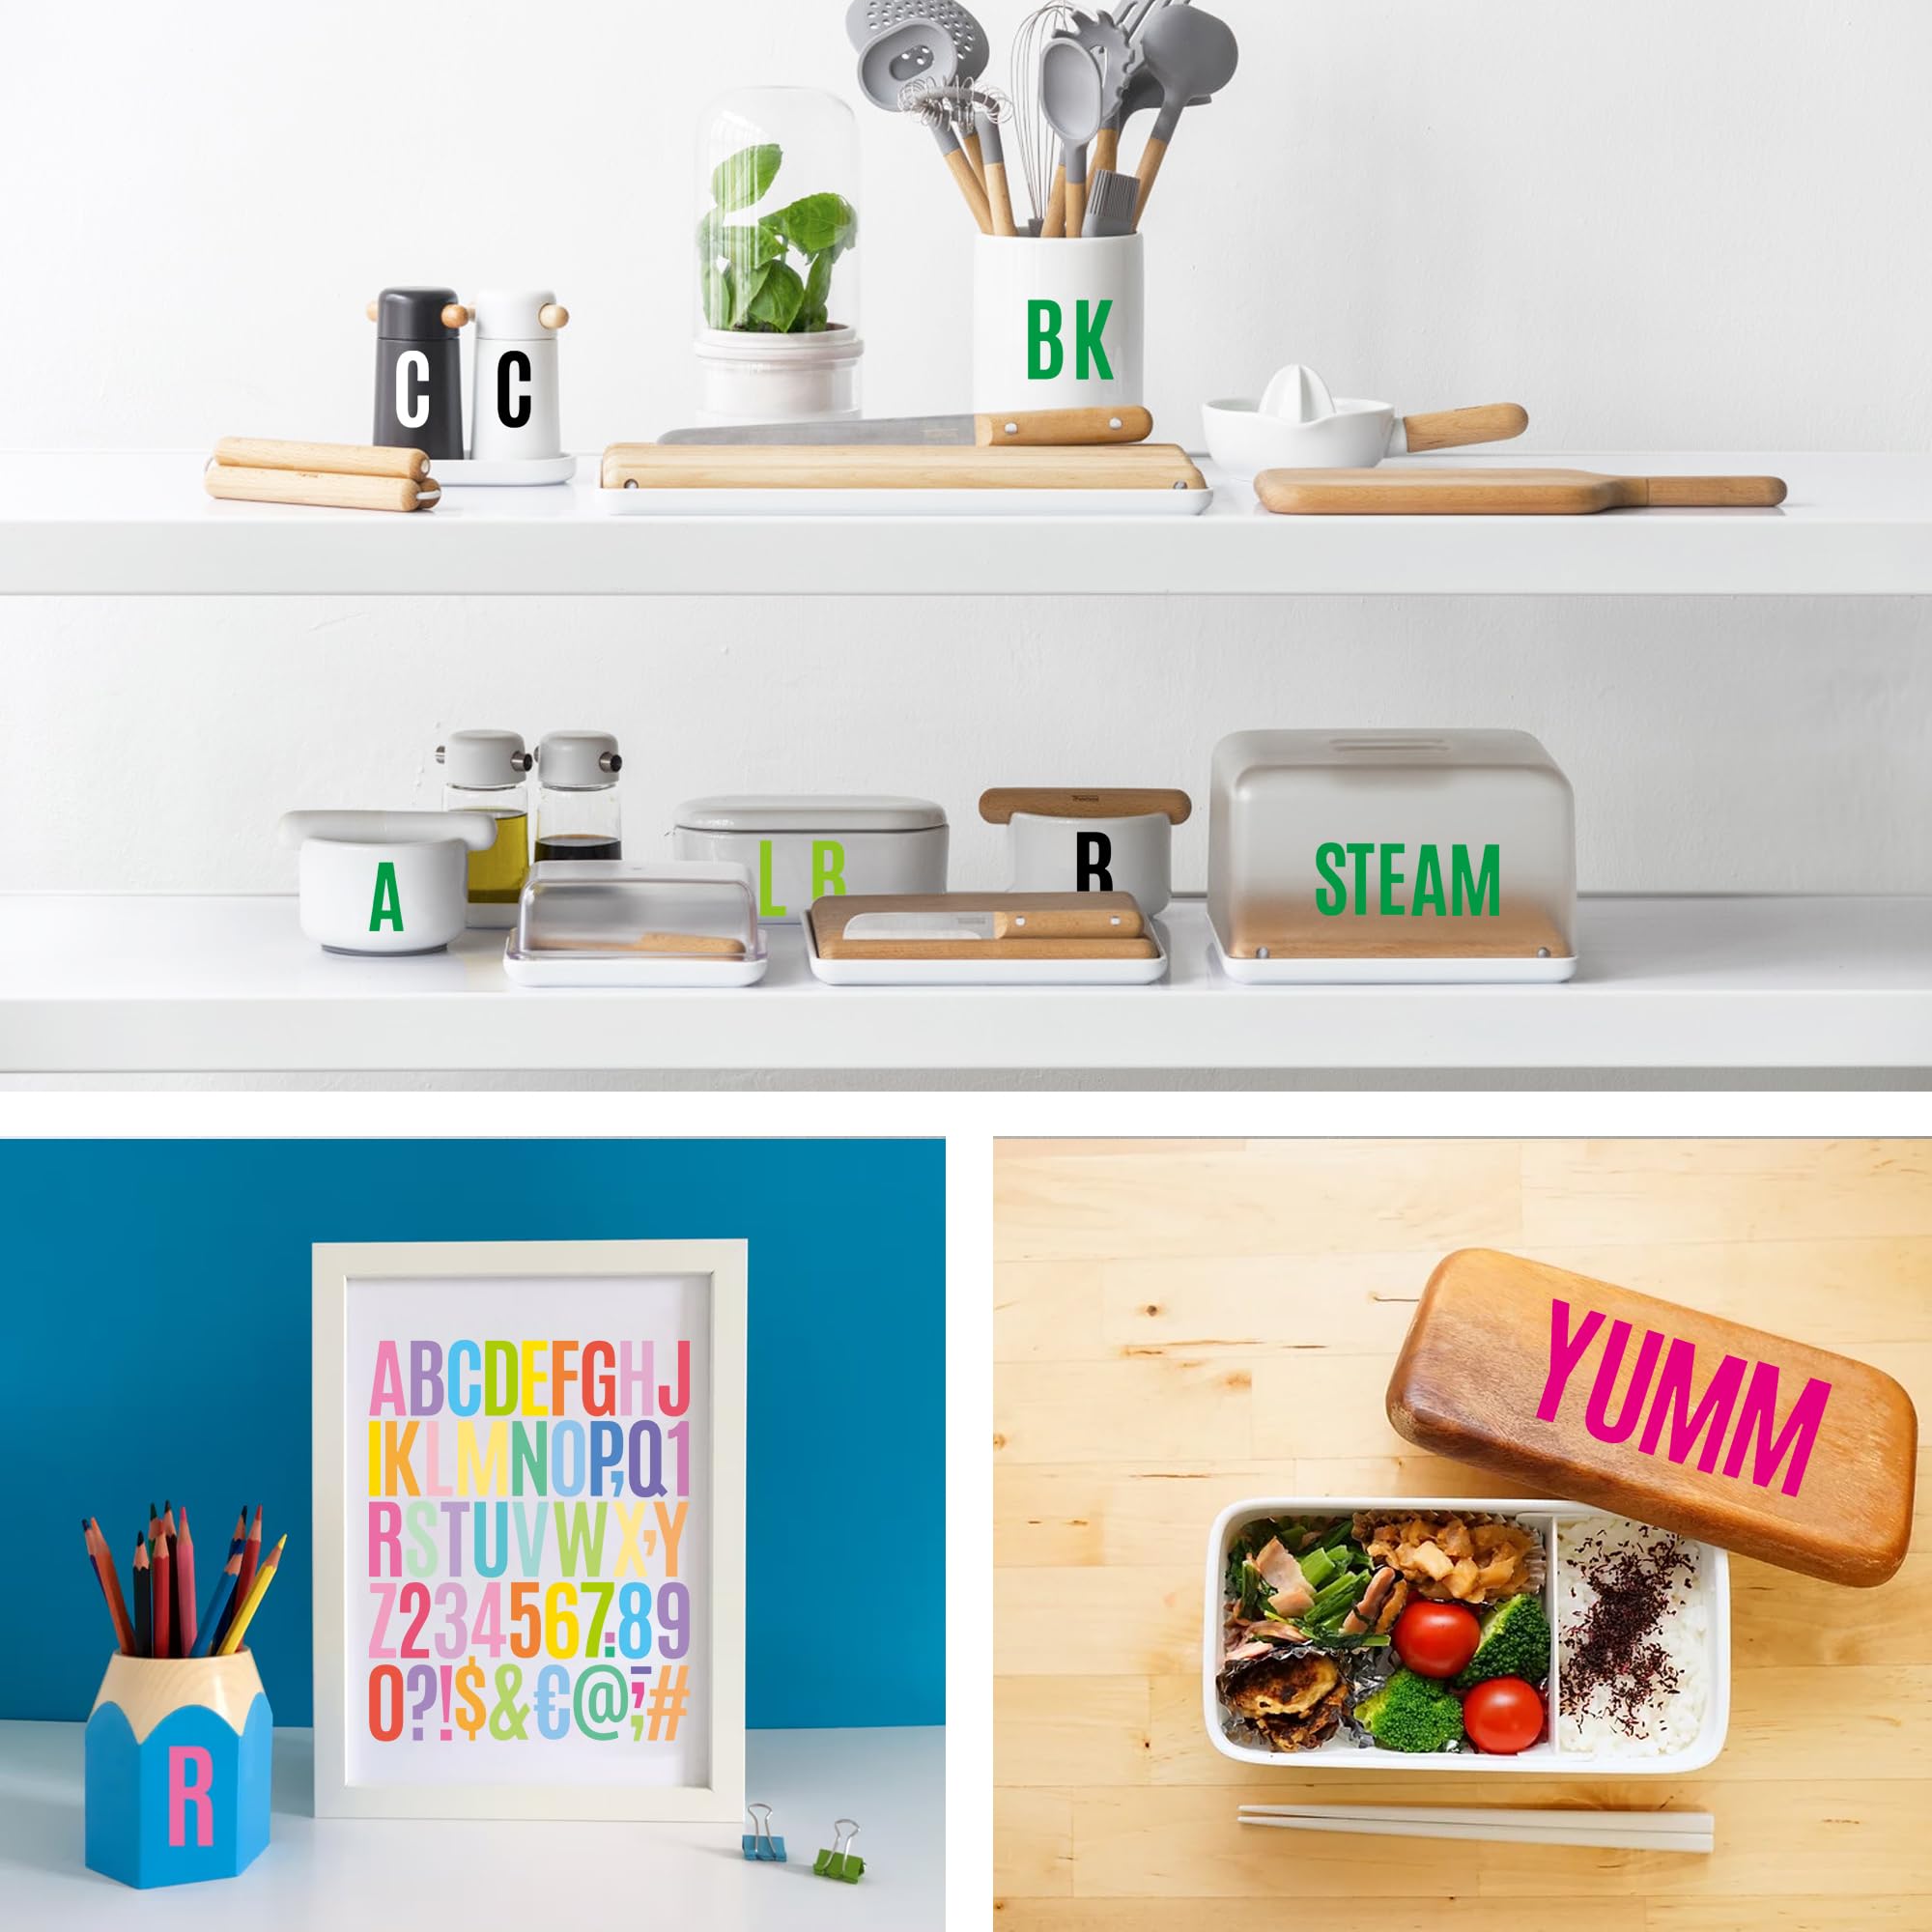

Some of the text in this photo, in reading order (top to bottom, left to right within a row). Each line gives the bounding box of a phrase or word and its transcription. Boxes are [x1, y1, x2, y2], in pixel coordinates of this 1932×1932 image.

[1027, 299, 1114, 381] BK
[395, 350, 430, 429] C
[497, 350, 531, 429] C
[368, 862, 404, 932] A
[759, 839, 786, 917] L
[1315, 841, 1500, 917] STEAM
[368, 1340, 691, 1417] ABCDEFGHJ
[1536, 1298, 1833, 1497] YUMM
[168, 1746, 213, 1847] R
